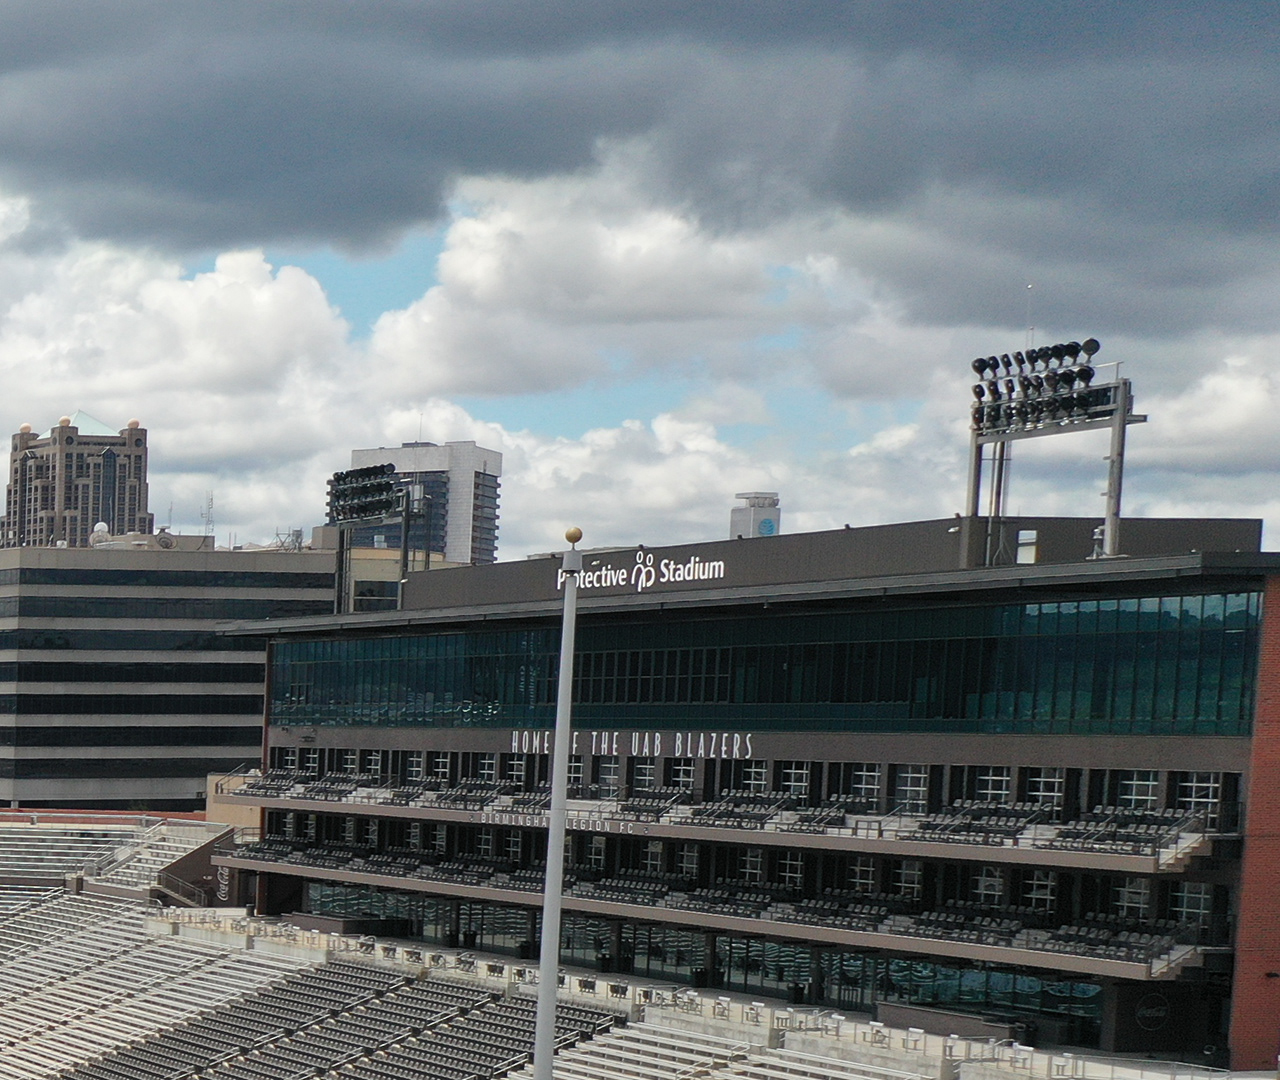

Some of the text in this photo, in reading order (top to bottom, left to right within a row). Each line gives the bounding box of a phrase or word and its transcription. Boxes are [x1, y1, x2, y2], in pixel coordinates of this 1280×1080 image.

[557, 556, 724, 590] Potective Stadium
[512, 731, 550, 754] HOME
[591, 731, 619, 755] THE
[631, 732, 661, 756] UAB
[675, 732, 752, 759] BLAZERS
[481, 813, 634, 834] BIRMINGHA LEGION FC
